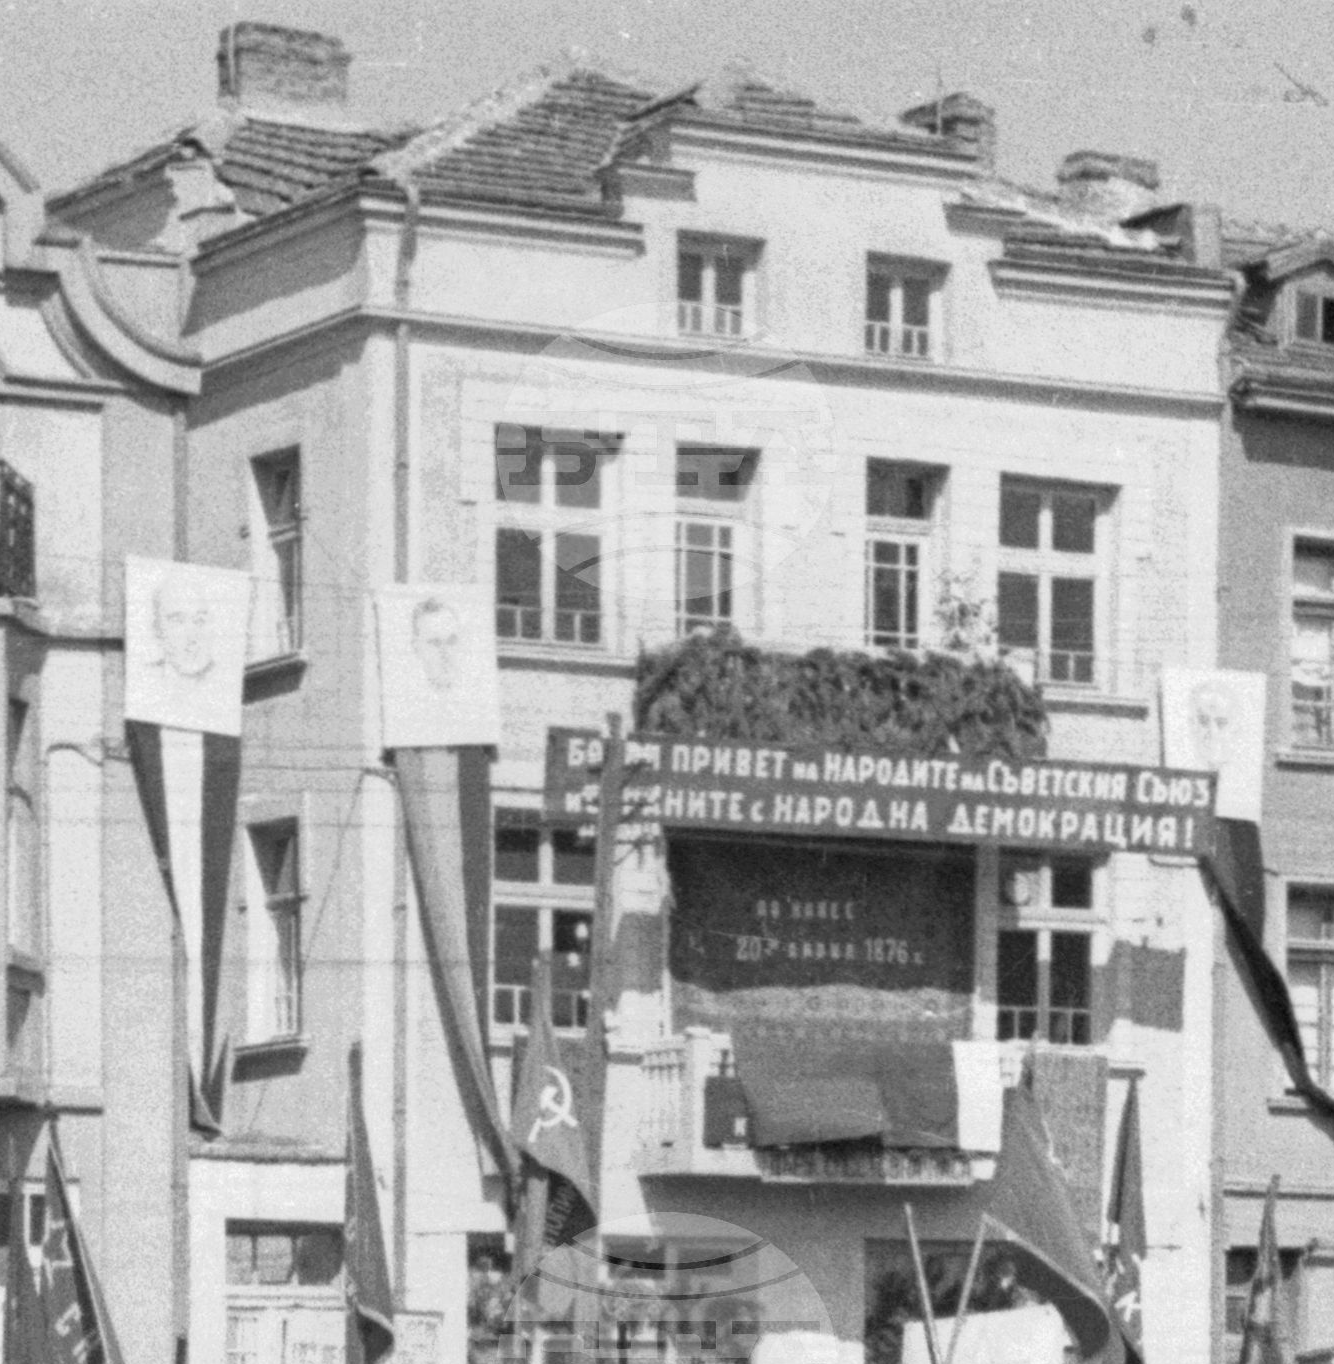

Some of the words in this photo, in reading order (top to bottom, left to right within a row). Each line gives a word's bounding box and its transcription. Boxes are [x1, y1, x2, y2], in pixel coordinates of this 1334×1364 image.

[672, 744, 786, 779] ПРИВЕТ
[824, 751, 960, 791] НАРОДИТЕ
[773, 793, 928, 832] НАРОДНА
[947, 802, 1194, 848] ДЕМОКРАЦИЯ!
